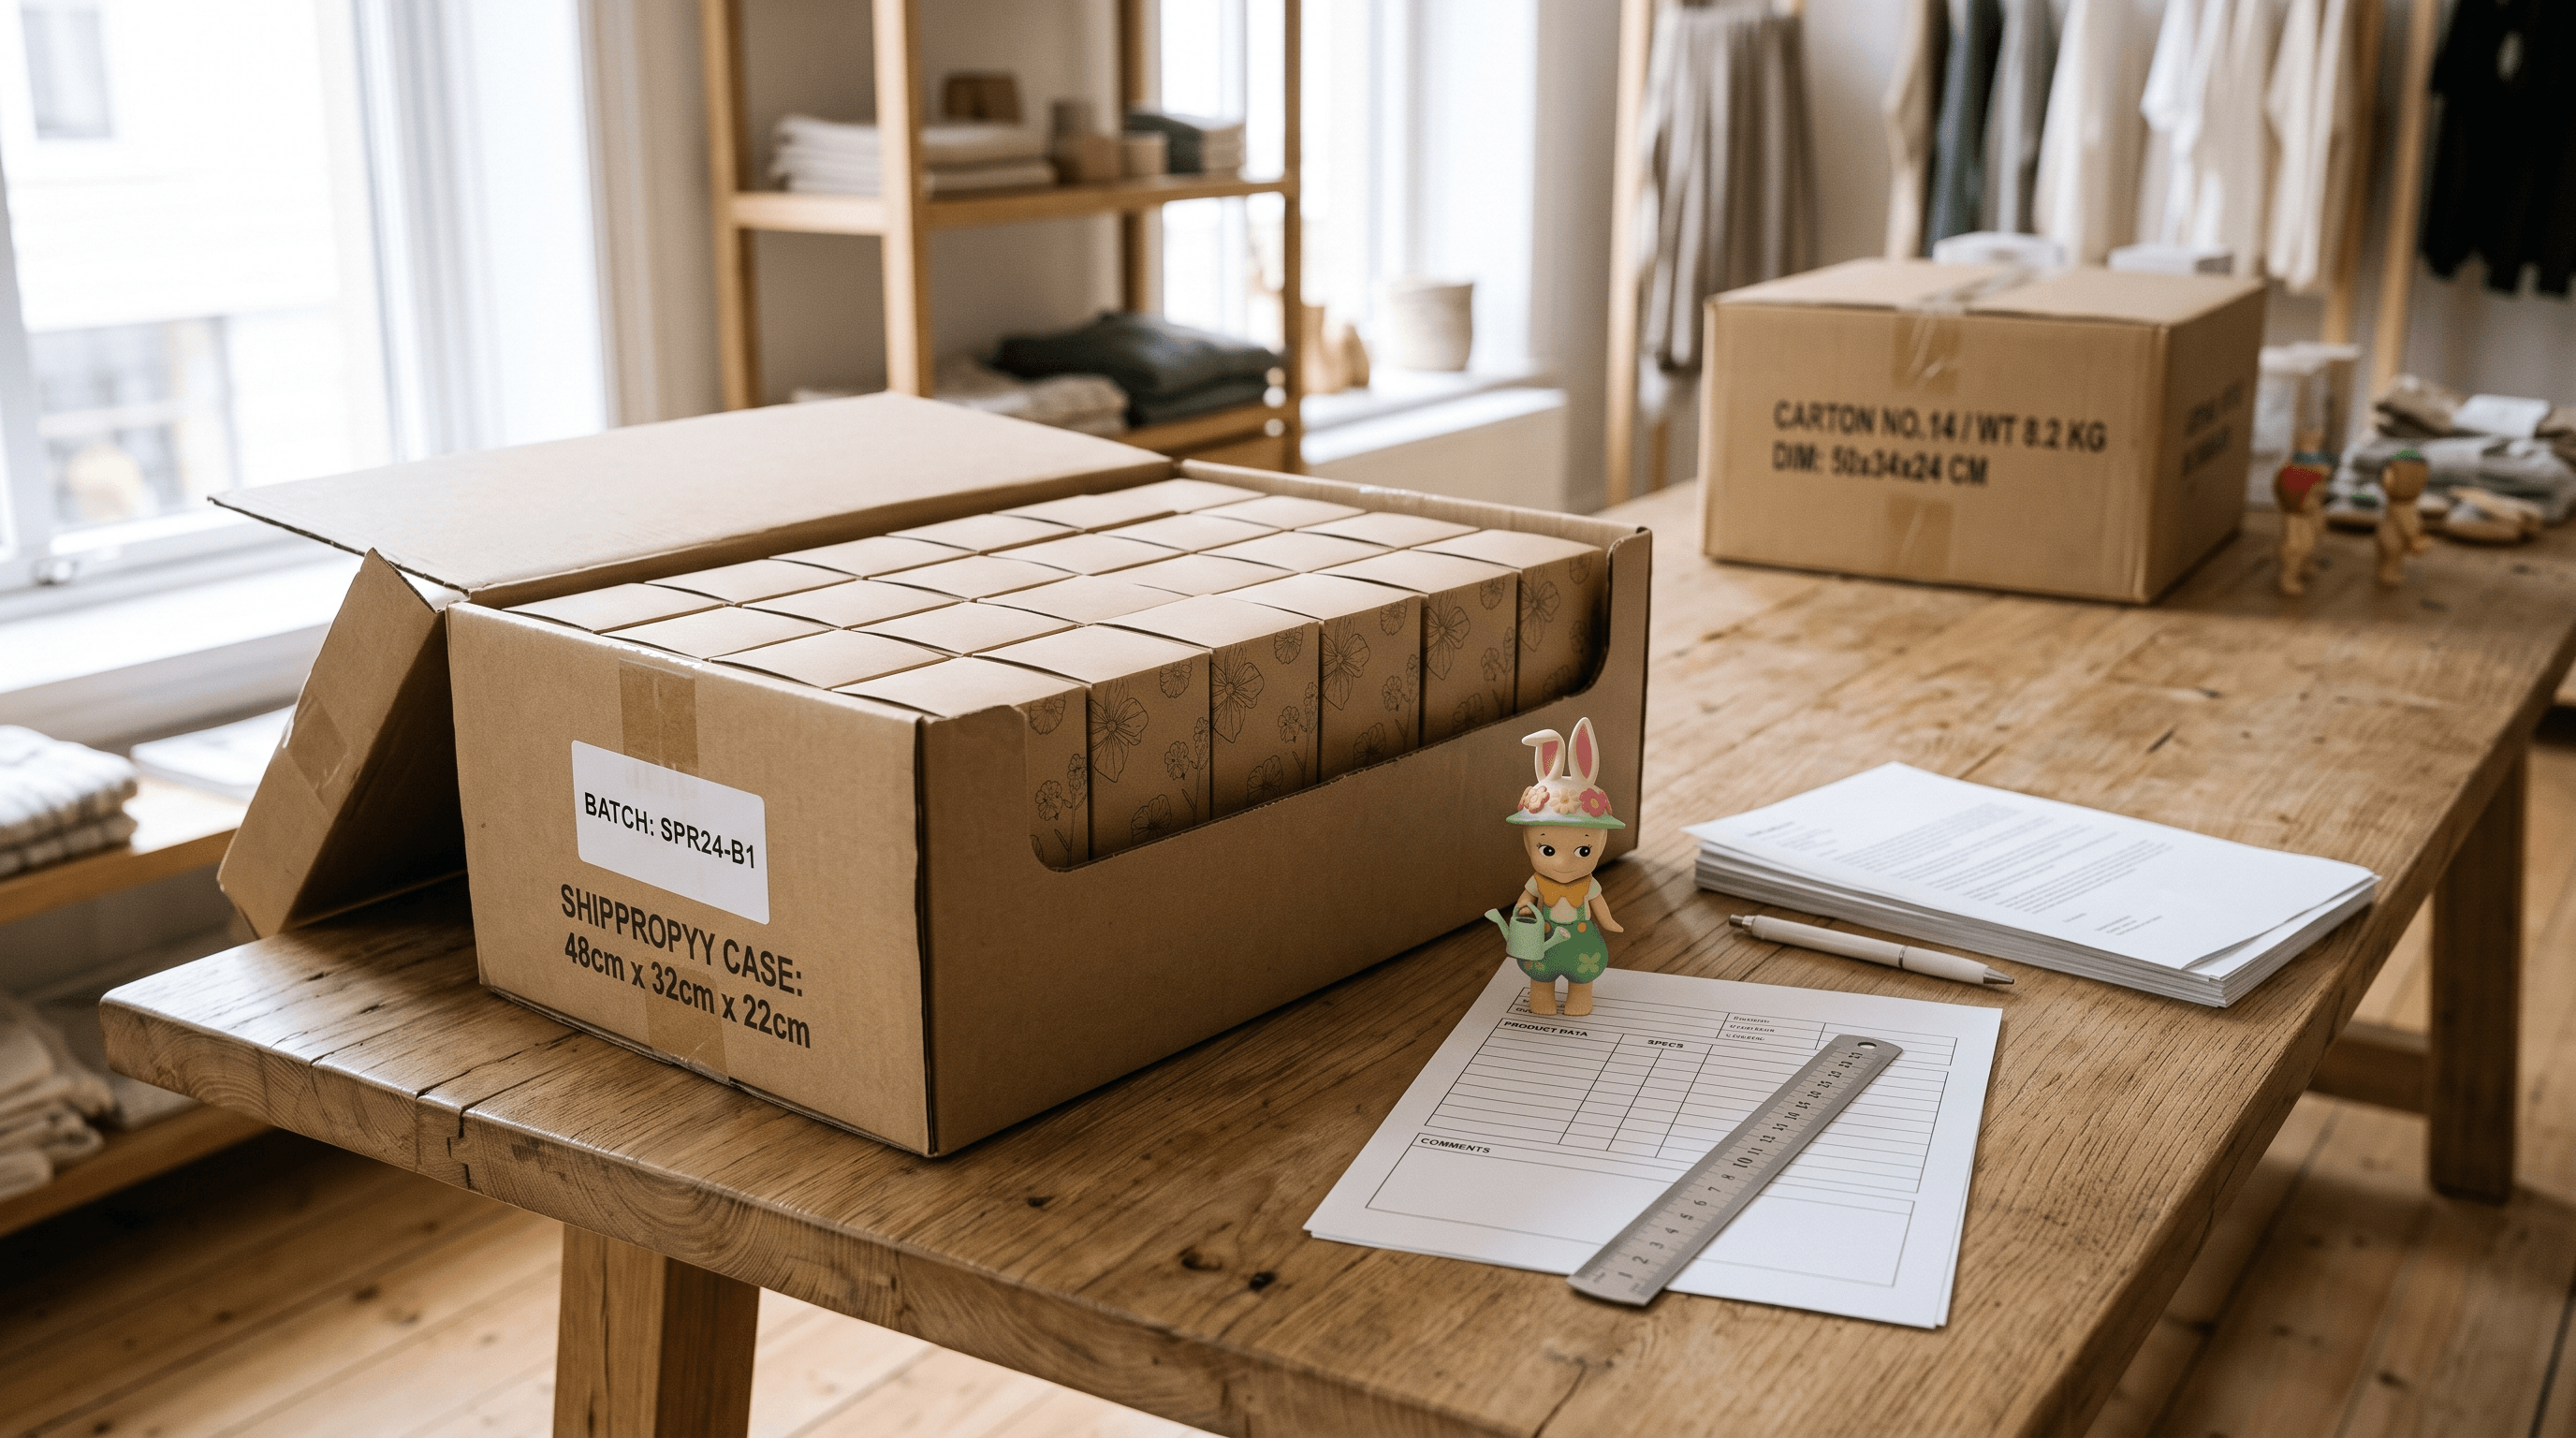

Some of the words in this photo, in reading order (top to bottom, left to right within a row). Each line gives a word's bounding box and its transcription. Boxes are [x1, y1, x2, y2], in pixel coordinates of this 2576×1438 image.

[1774, 400, 1874, 435] CARTON
[1976, 412, 2016, 445] WT
[2023, 415, 2061, 450] 8.2
[2066, 419, 2106, 453] KG
[1772, 440, 1823, 474] DIM:
[1948, 453, 1988, 486] CM
[584, 792, 654, 836] BATCH:
[661, 817, 755, 869] SPR24-B1
[561, 884, 715, 966] SHIPPROPYY
[724, 938, 803, 997] CASE:
[564, 932, 624, 982] 48cm
[631, 961, 646, 990] x
[652, 961, 715, 1014] 32cm
[722, 993, 737, 1022] x
[743, 993, 811, 1049] 22cm
[1503, 1021, 1558, 1034] PRODUCT
[1420, 1137, 1491, 1153] COMMENTS
[1632, 1255, 1649, 1265] 2
[1649, 1241, 1664, 1250] 3
[1733, 1157, 1753, 1168] 10
[1748, 1147, 1764, 1155] 11
